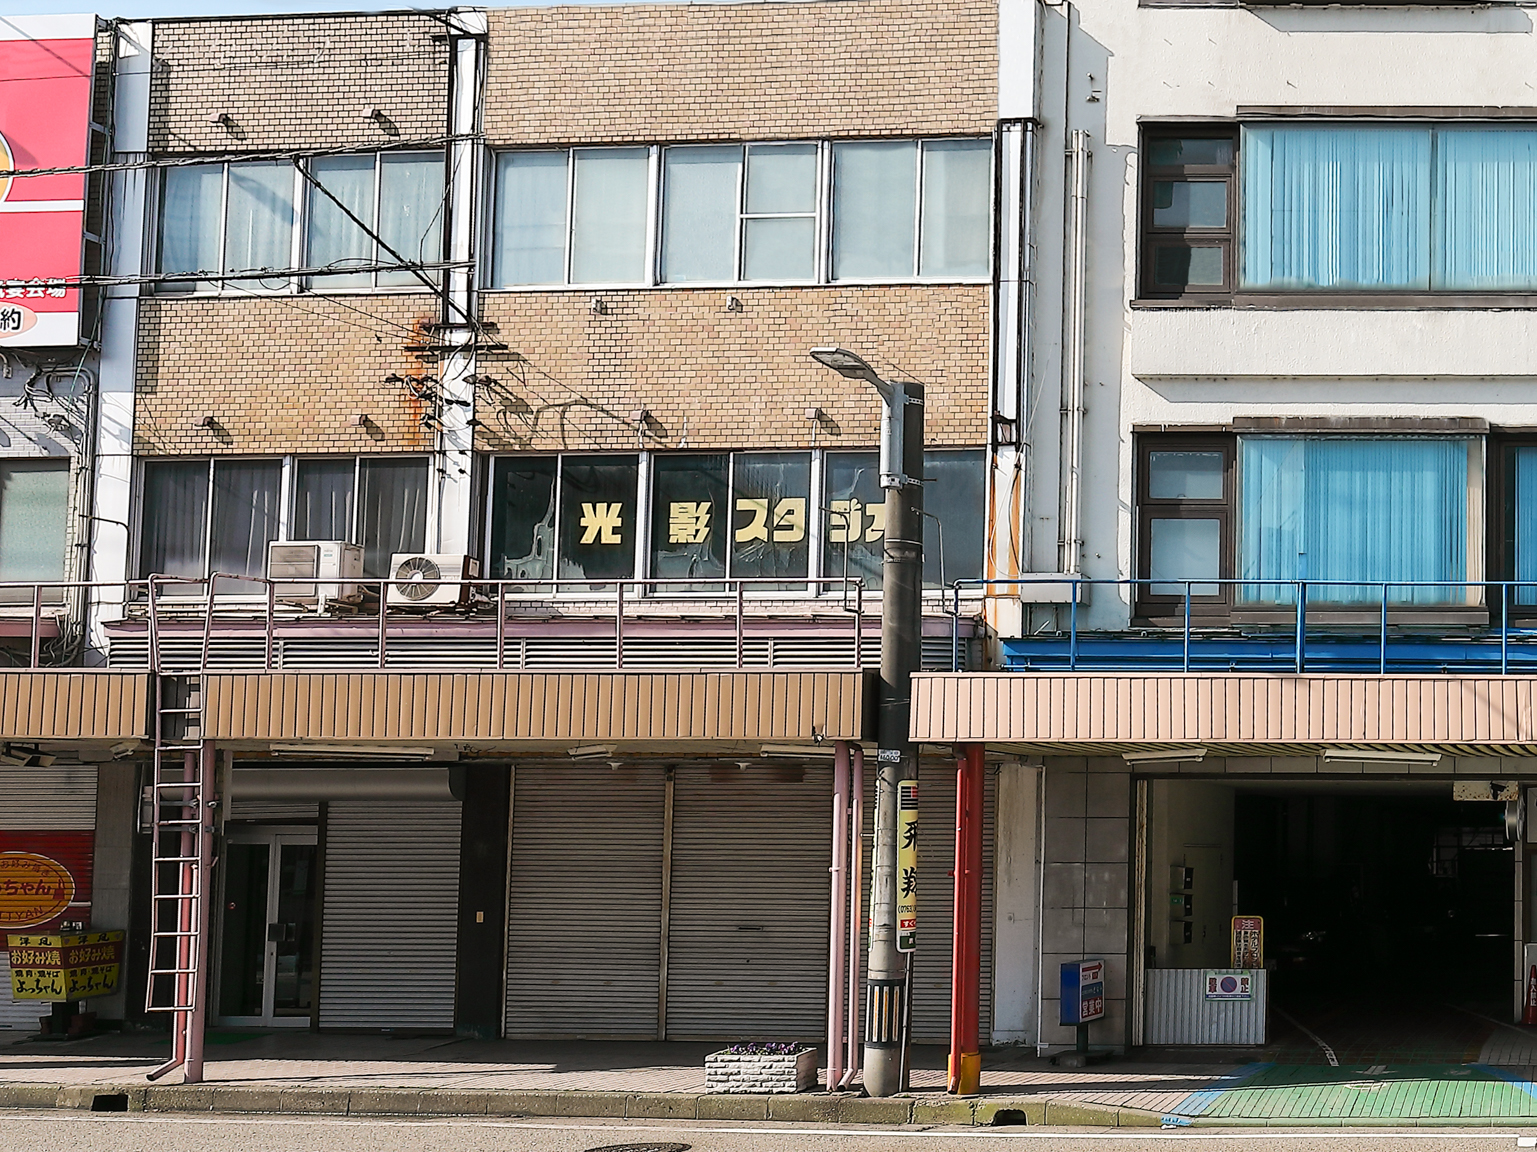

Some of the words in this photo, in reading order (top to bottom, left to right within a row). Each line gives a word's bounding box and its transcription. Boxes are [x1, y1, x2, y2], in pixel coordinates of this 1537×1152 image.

[0, 276, 67, 298] 宴会場
[0, 879, 52, 895] ちゃん
[11, 949, 61, 965] お好み焼
[69, 946, 115, 965] お好み焼
[16, 978, 62, 995] よっちゃん
[69, 974, 114, 993] よっちゃん
